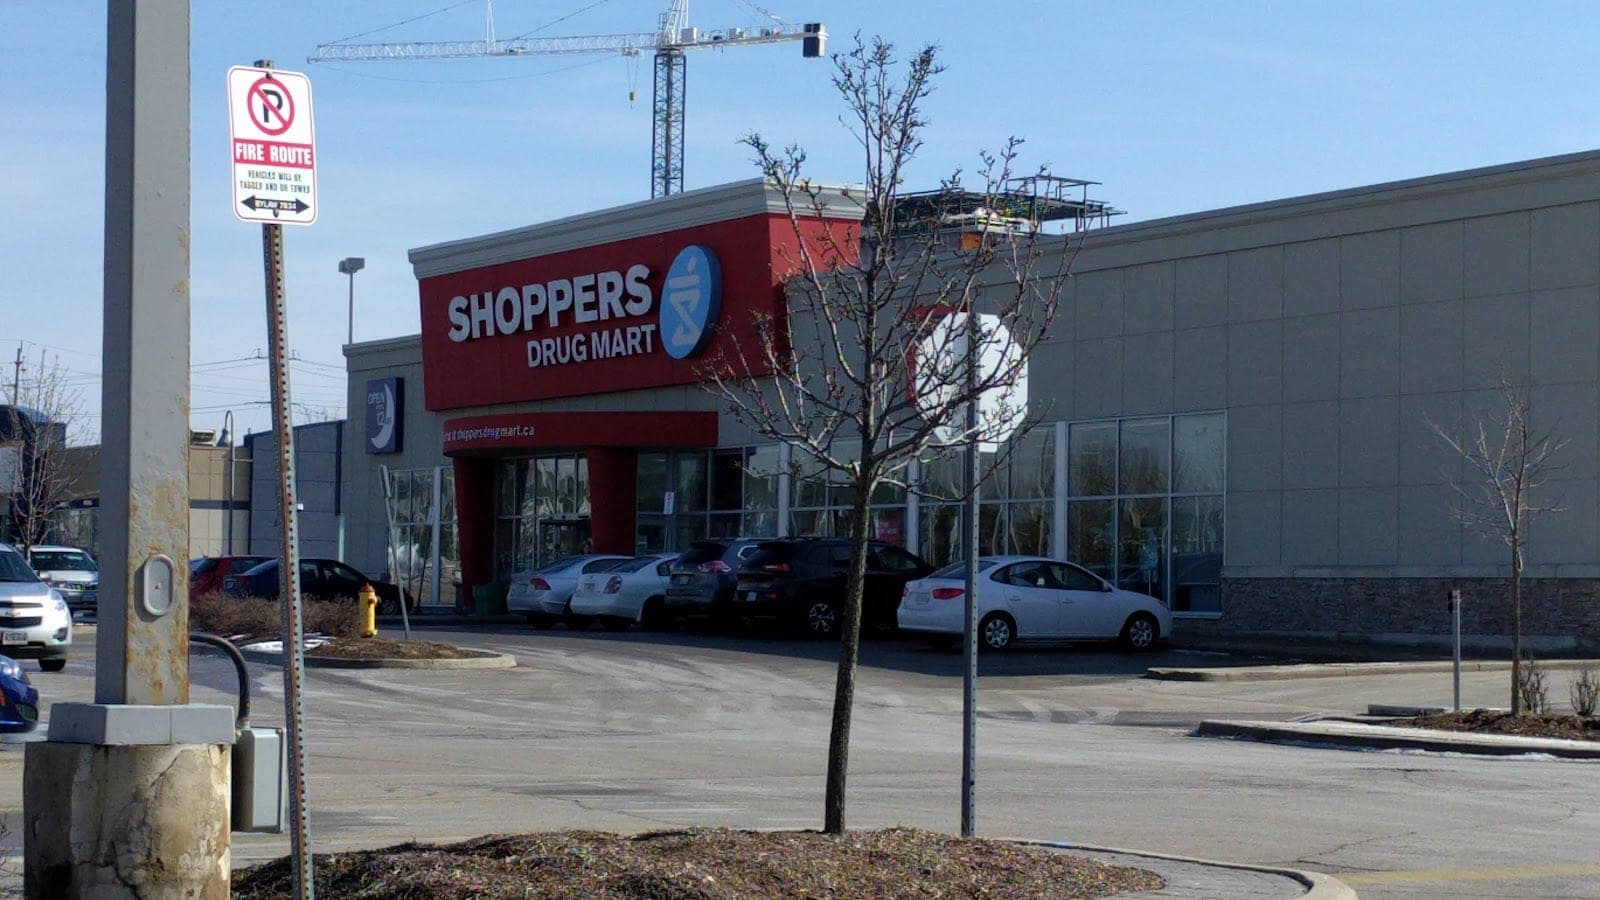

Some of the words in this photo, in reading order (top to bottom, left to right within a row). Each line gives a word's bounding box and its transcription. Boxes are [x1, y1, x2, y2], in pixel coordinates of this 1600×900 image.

[235, 142, 265, 161] FIRE
[269, 145, 313, 165] ROUTE
[248, 170, 276, 180] VEHICLES
[278, 172, 292, 181] WILL
[294, 173, 302, 182] BE
[240, 180, 263, 190] TAGGED
[265, 182, 278, 192] AND
[280, 183, 288, 192] OR
[290, 184, 311, 194] TOWED
[255, 199, 279, 209] BYLAW
[447, 264, 653, 343] SHOPPERS
[527, 333, 588, 368] DRUG
[591, 324, 656, 360] MART
[367, 391, 385, 405] OPEN
